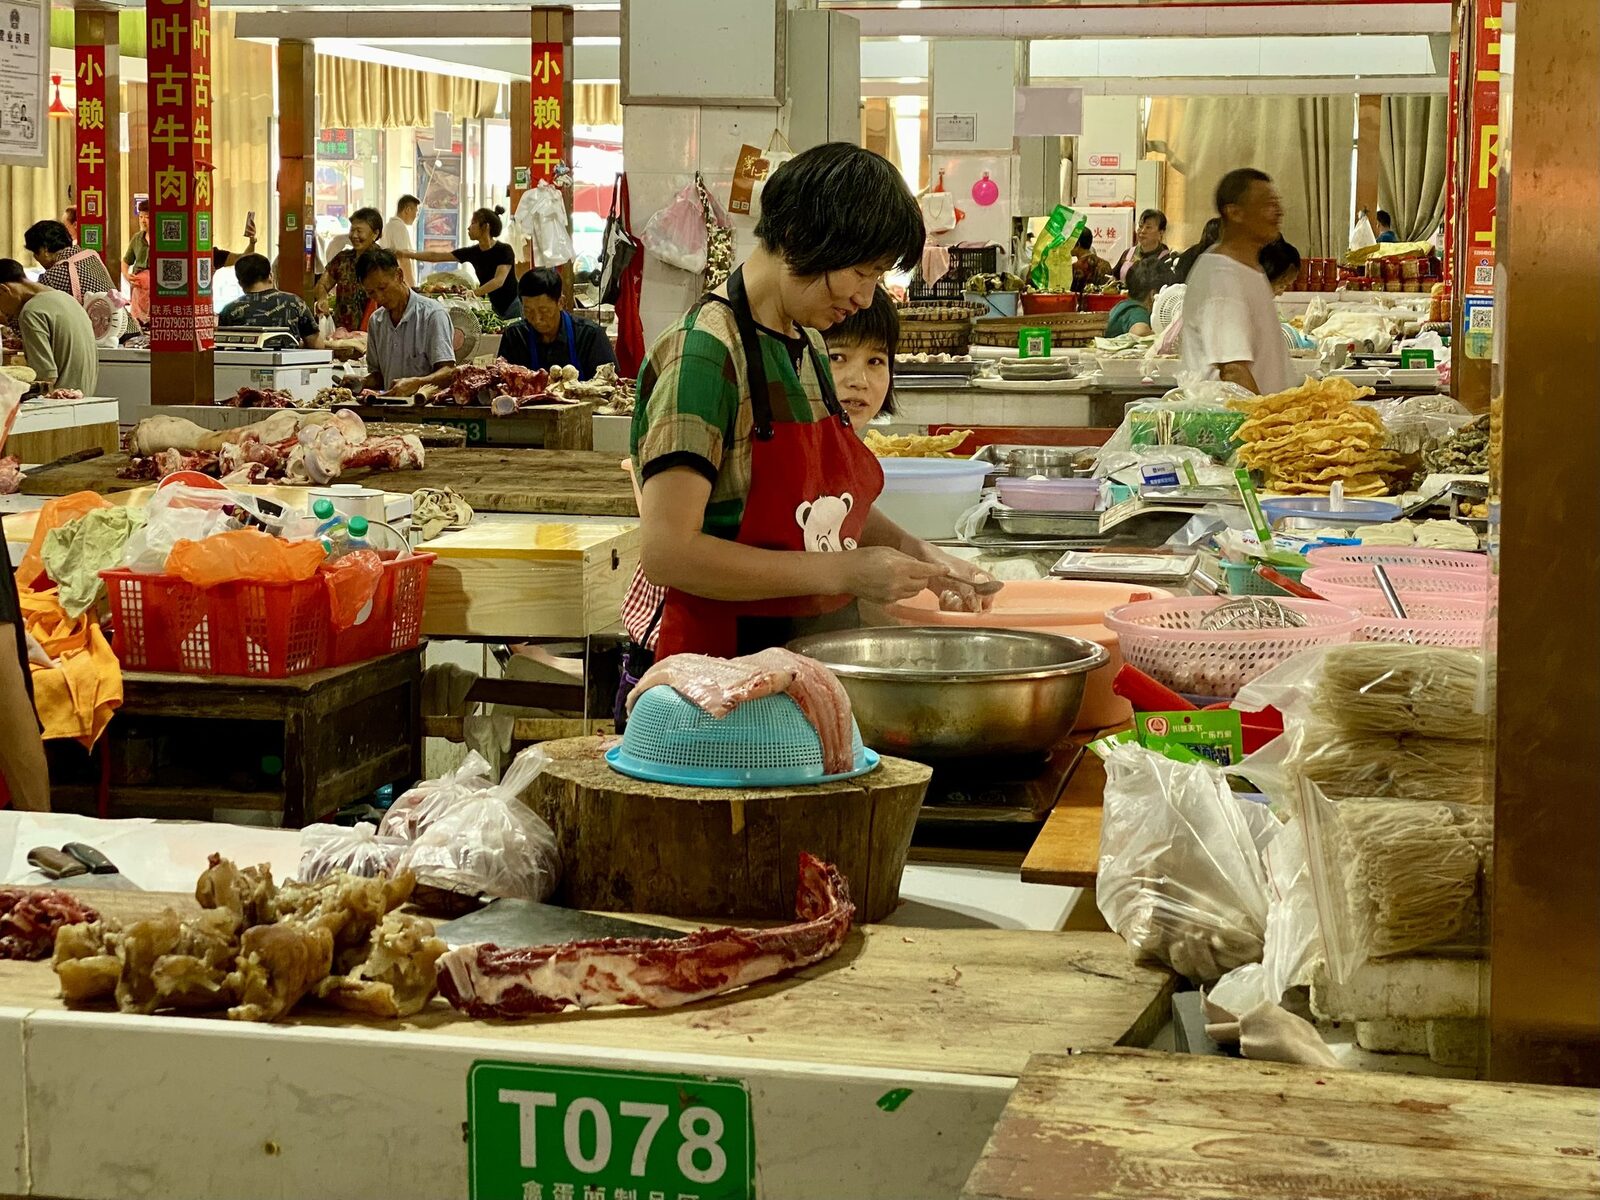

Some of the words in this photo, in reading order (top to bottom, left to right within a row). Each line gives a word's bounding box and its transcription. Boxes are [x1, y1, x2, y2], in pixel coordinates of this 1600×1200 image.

[150, 0, 189, 207] 叶古牛肉
[192, 0, 212, 207] 叶古牛肉
[533, 51, 561, 175] 小赖牛
[151, 304, 193, 315] 联系电话
[498, 1088, 727, 1184] T078
